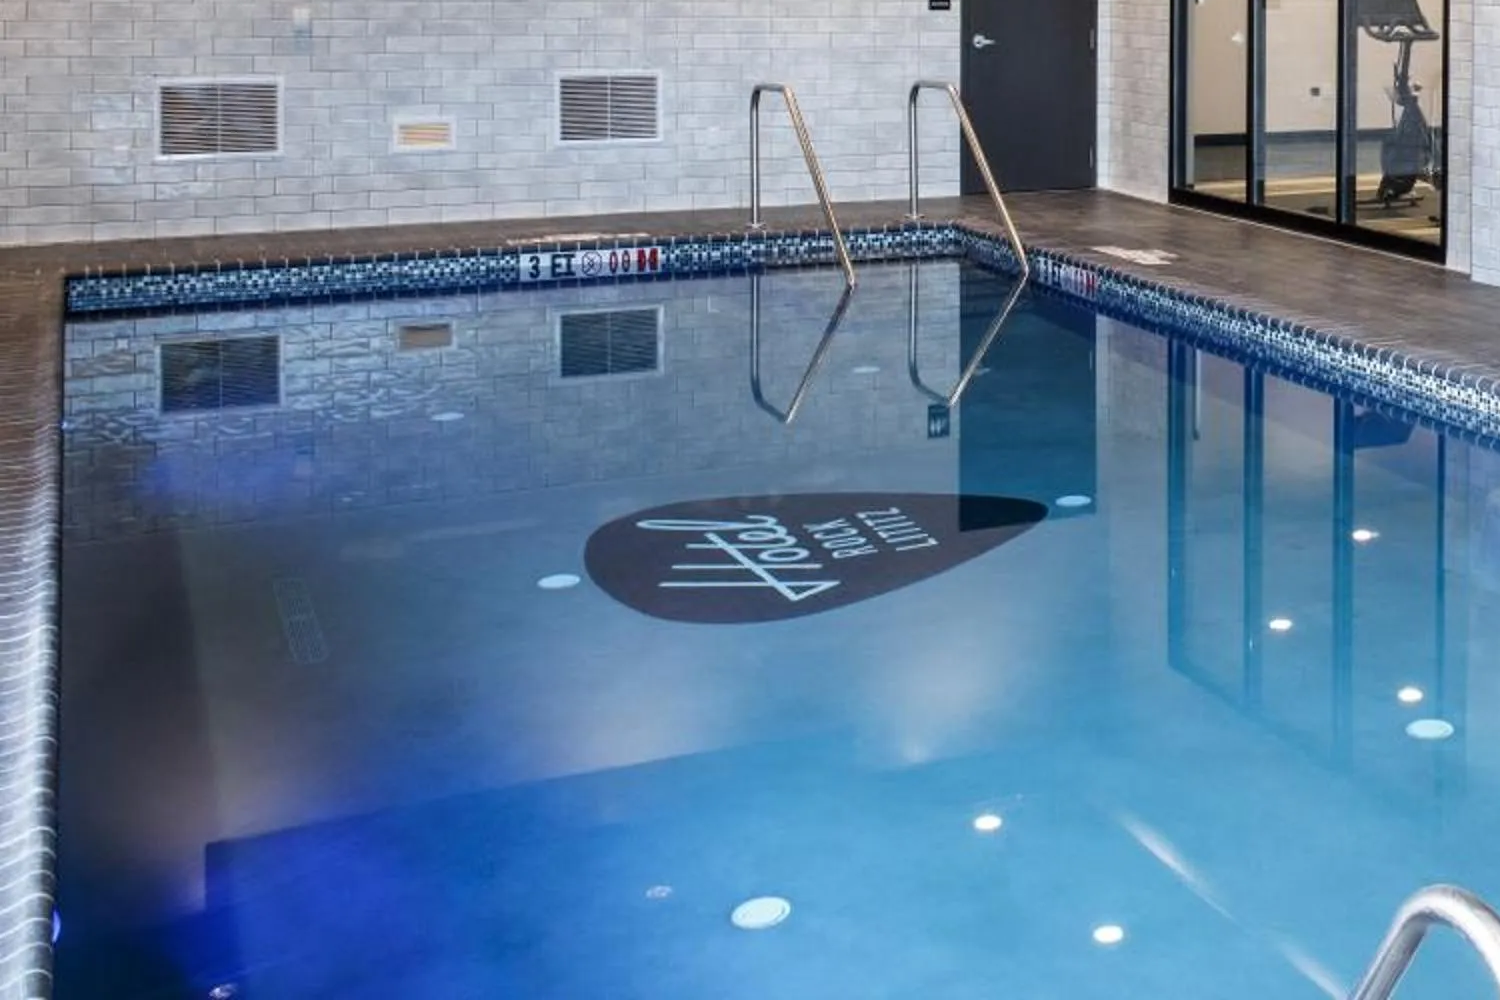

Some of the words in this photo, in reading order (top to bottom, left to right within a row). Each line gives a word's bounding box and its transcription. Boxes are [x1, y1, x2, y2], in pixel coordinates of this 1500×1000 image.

[803, 518, 879, 560] ROCK
[857, 507, 939, 551] LITITZ
[636, 515, 841, 601] Hotel
